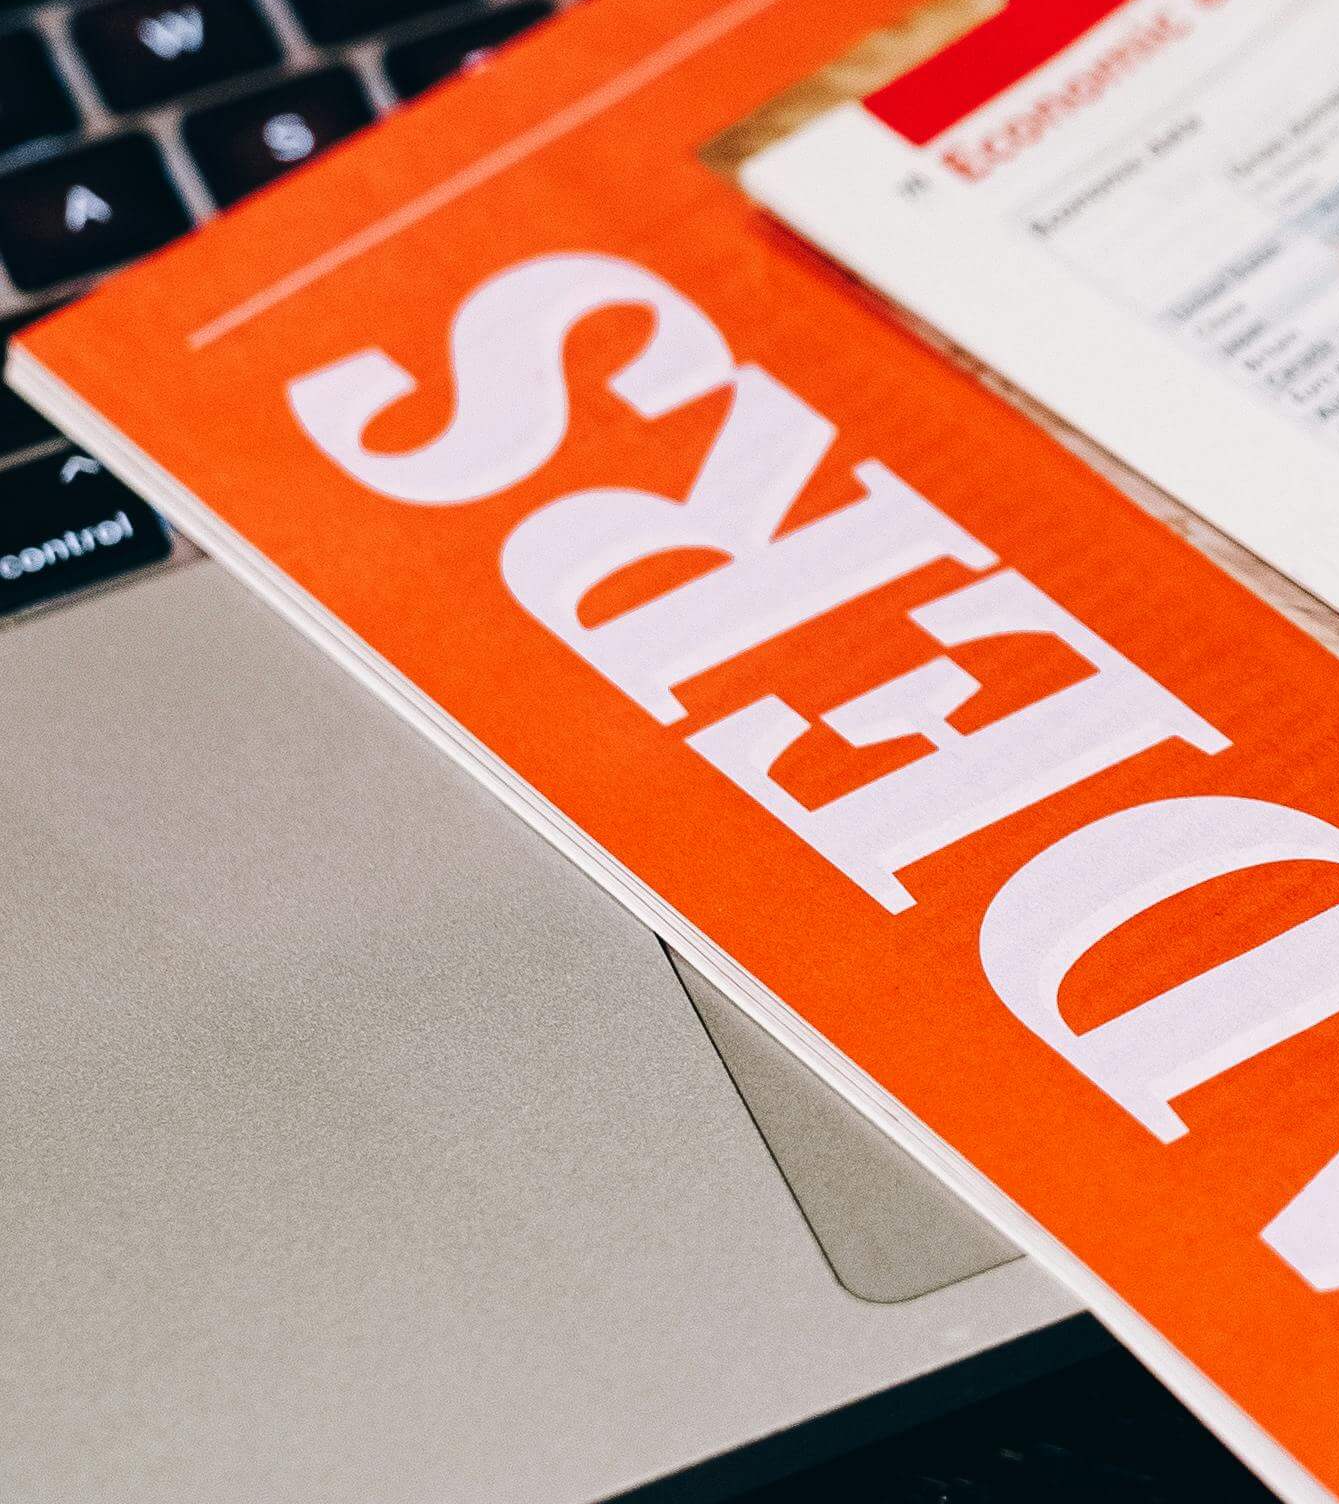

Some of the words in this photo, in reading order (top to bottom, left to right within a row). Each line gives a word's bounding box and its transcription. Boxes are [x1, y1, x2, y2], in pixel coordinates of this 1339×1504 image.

[139, 6, 204, 60] W
[262, 111, 316, 163] S
[65, 184, 113, 233] A
[0, 510, 133, 580] control
